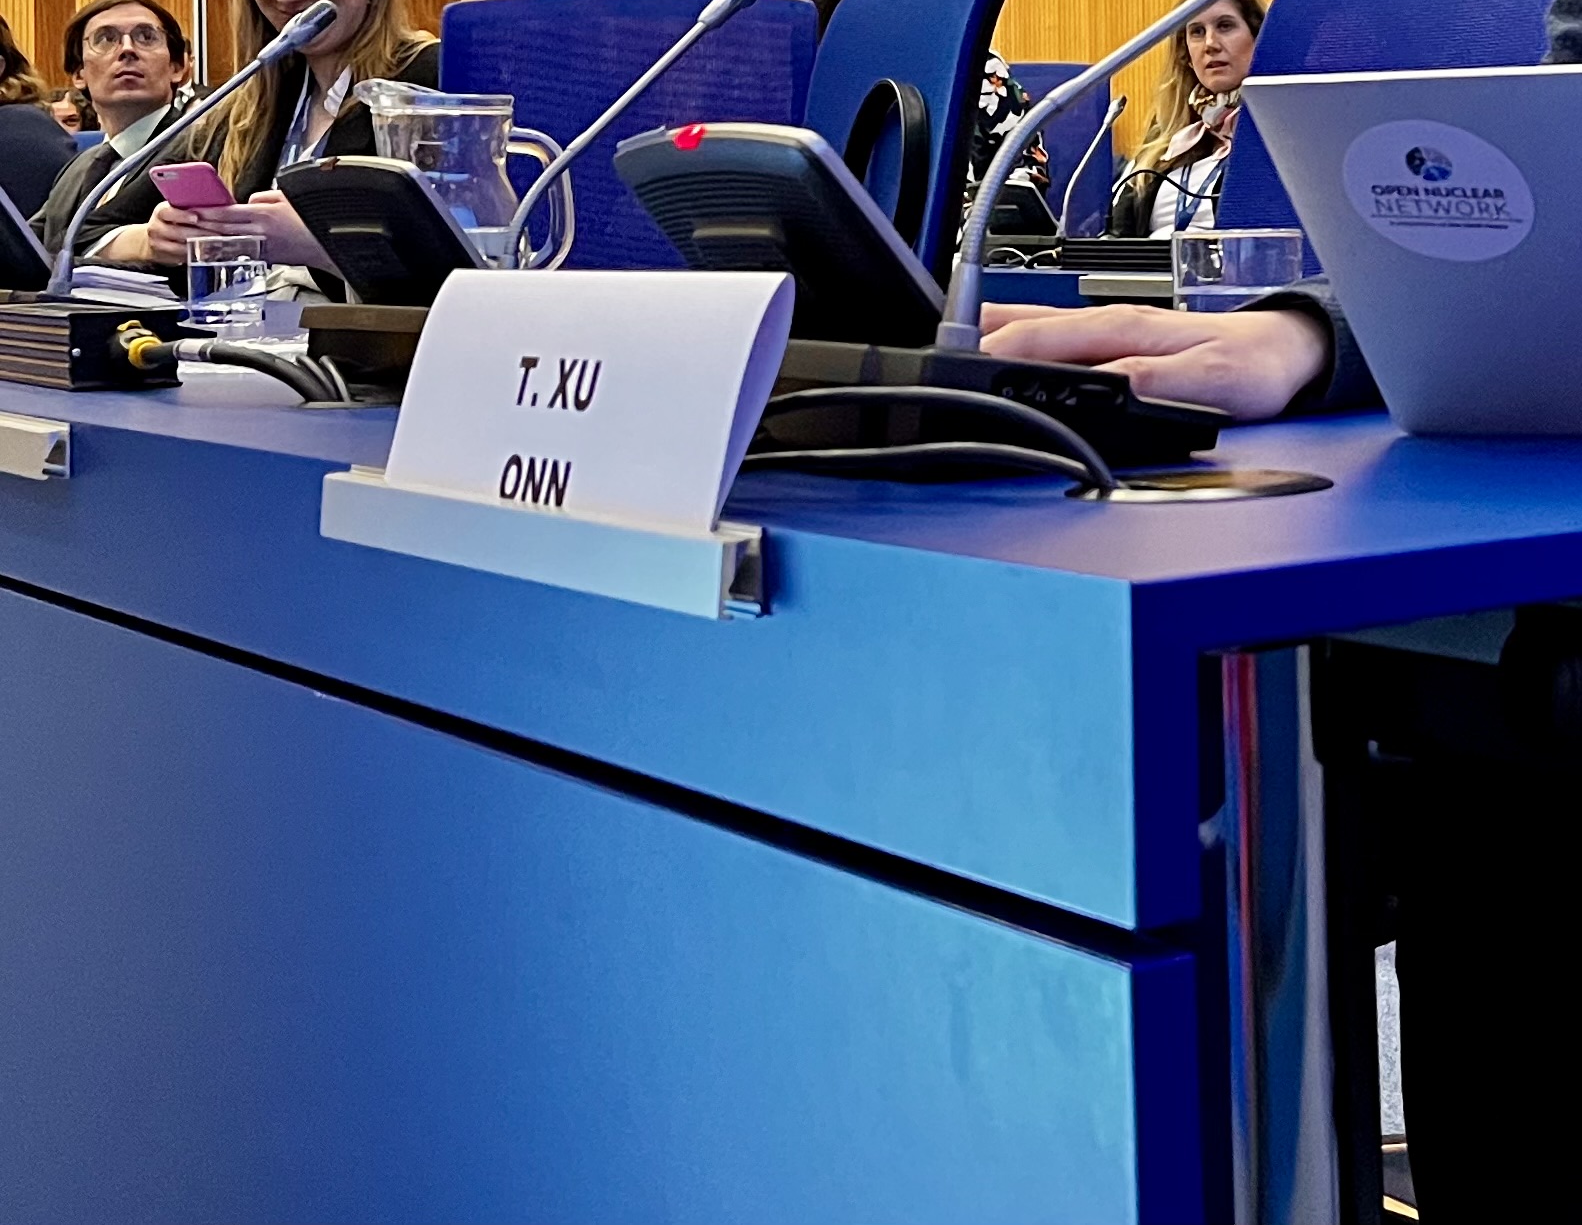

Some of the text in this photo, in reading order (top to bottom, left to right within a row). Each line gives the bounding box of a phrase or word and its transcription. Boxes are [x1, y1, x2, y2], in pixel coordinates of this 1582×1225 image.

[1371, 185, 1505, 199] OPEN NUCLEAR
[1374, 198, 1511, 218] NETWORK
[516, 356, 602, 411] T. XU
[499, 454, 572, 507] ONN
